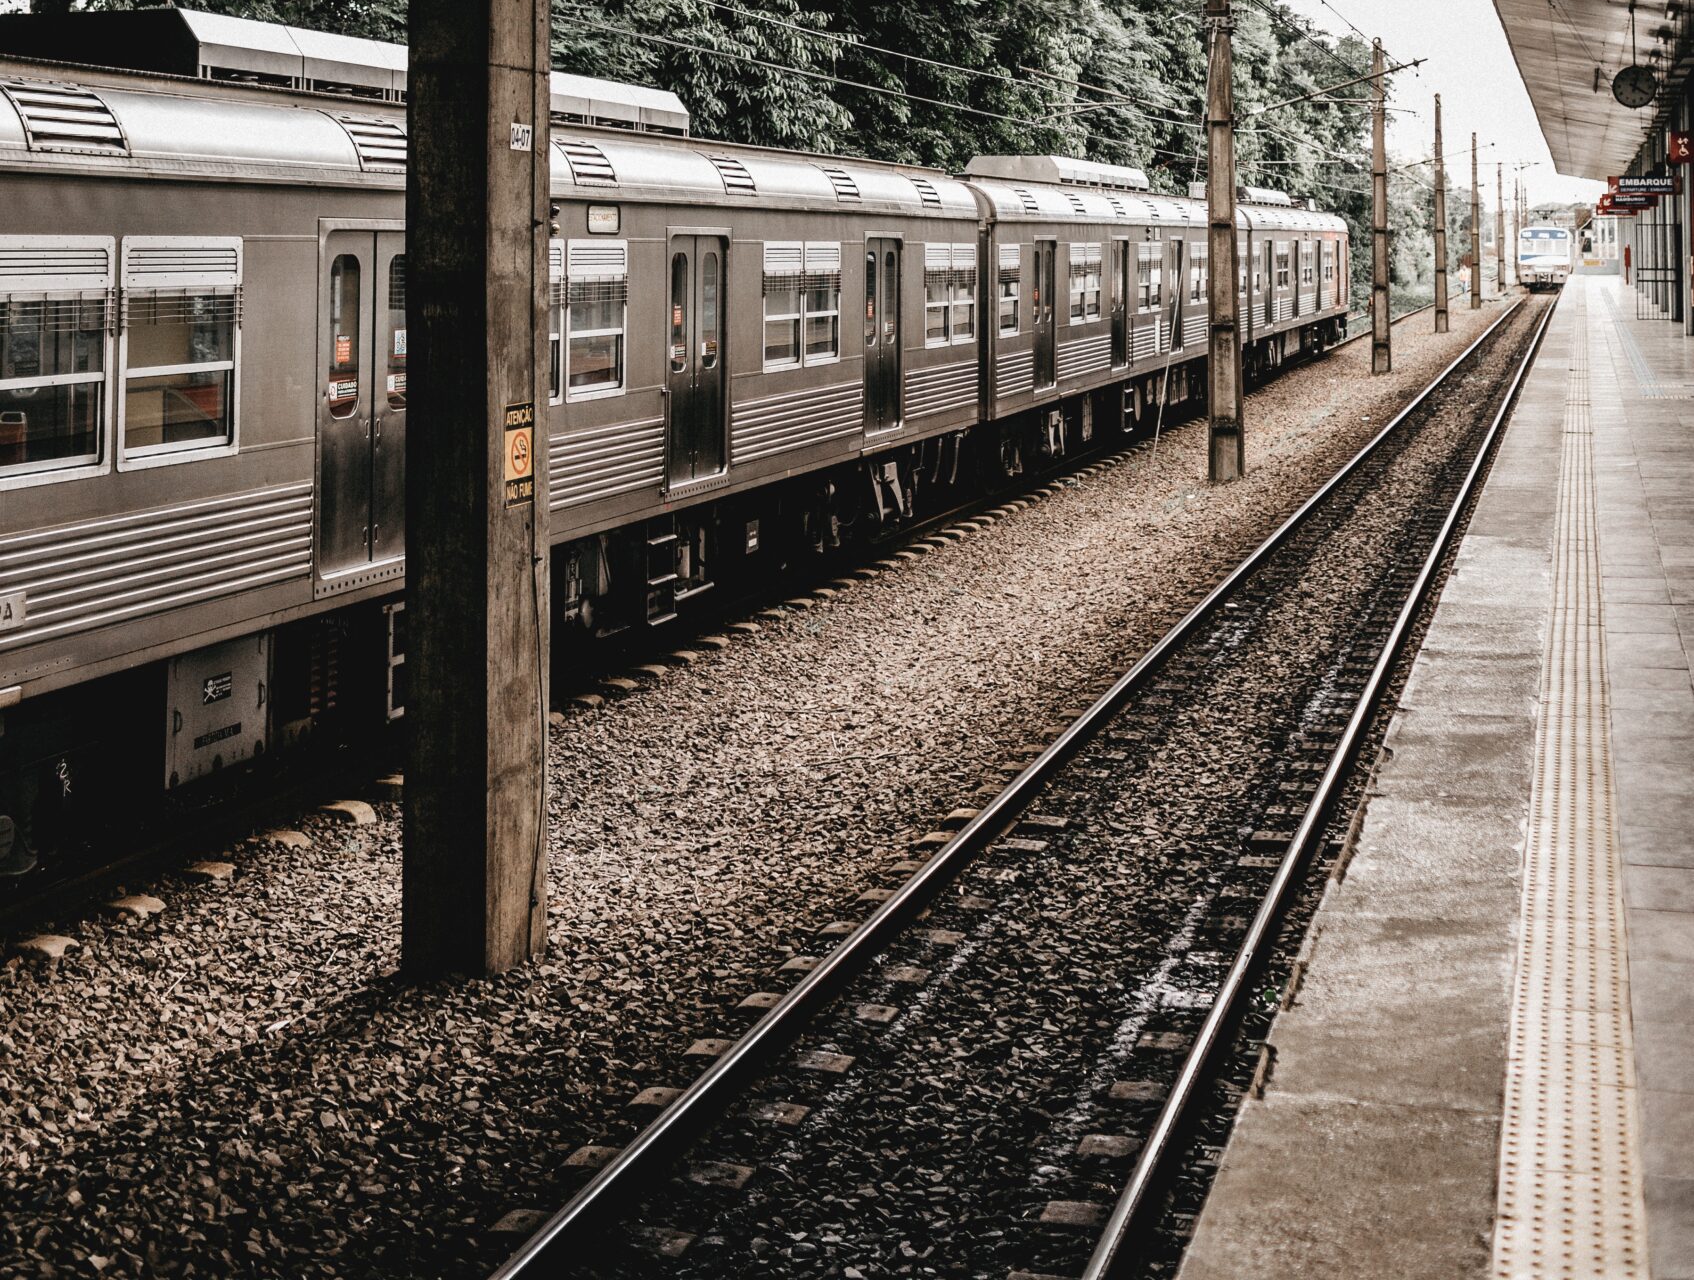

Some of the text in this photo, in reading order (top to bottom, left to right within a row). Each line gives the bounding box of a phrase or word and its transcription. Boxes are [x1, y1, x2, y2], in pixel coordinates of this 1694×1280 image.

[1619, 178, 1673, 186] EMBARQUE
[338, 381, 357, 390] CUIDADO
[506, 405, 533, 426] ATENÇÃO
[506, 481, 533, 500] NÃO FUME
